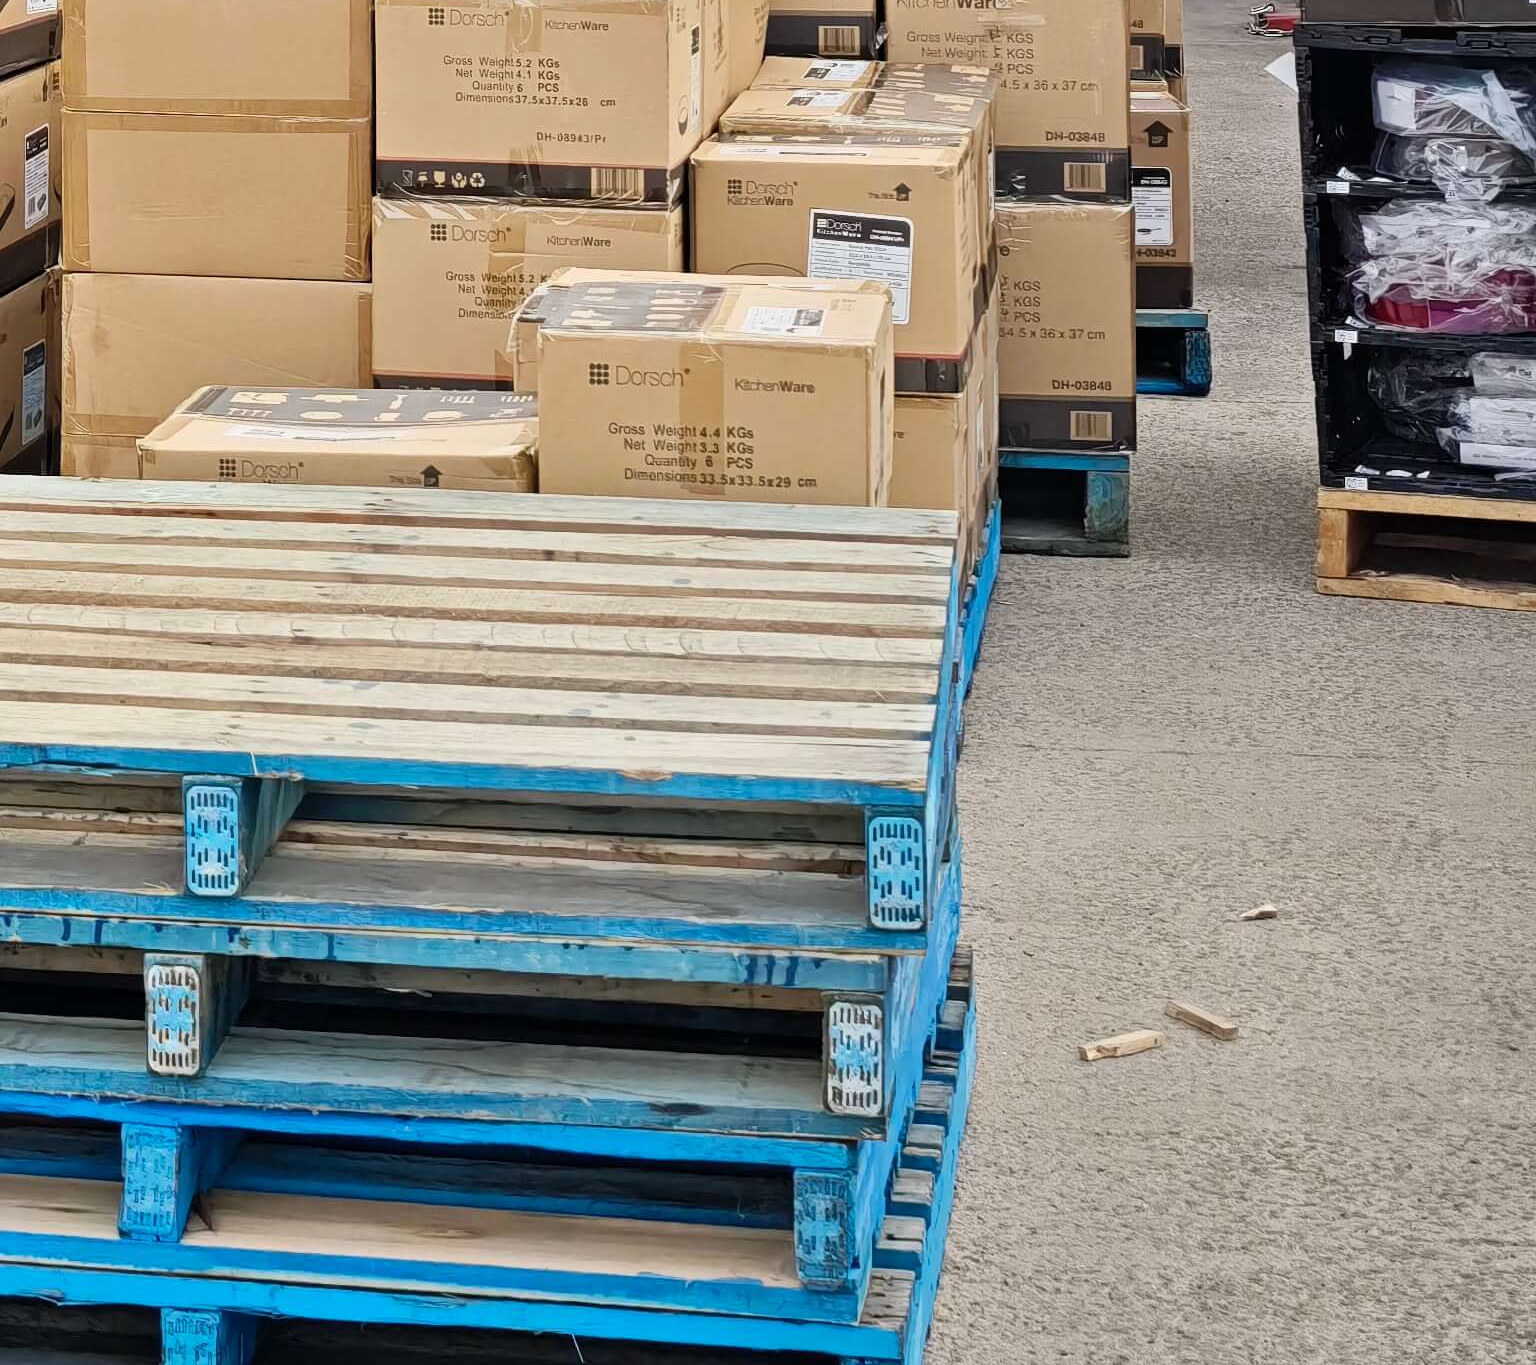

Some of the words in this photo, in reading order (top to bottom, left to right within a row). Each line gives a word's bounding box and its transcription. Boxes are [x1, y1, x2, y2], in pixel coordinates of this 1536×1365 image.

[444, 56, 472, 65] Gross
[479, 57, 514, 69] Weight
[516, 59, 532, 67] 5.2
[538, 59, 560, 68] KGs
[616, 366, 684, 386] Dorsch
[609, 423, 645, 435] Gross
[653, 424, 696, 438] Weight
[700, 427, 720, 438] 4.4
[727, 427, 754, 439] KGs
